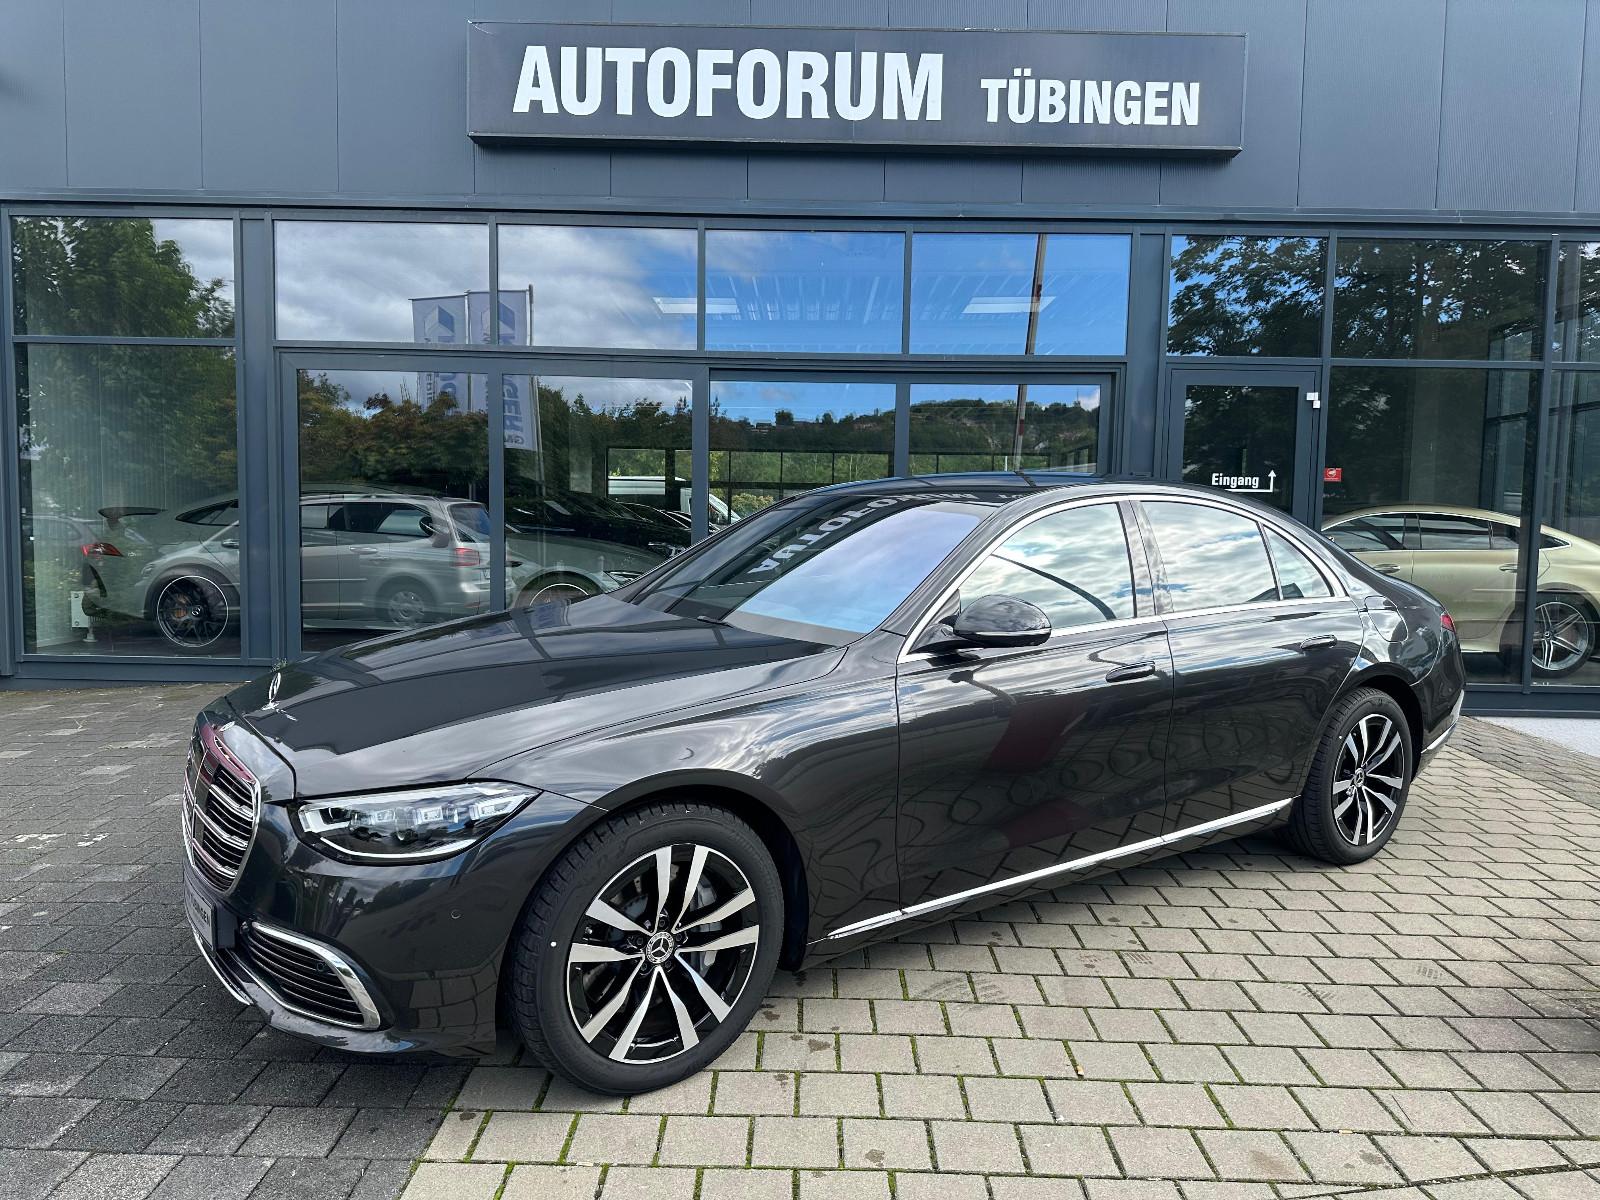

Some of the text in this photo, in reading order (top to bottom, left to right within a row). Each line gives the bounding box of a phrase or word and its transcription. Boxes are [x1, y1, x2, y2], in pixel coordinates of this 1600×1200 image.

[512, 45, 1200, 126] AUTOFORUM TÜBINGEN
[1211, 473, 1260, 489] Eingang
